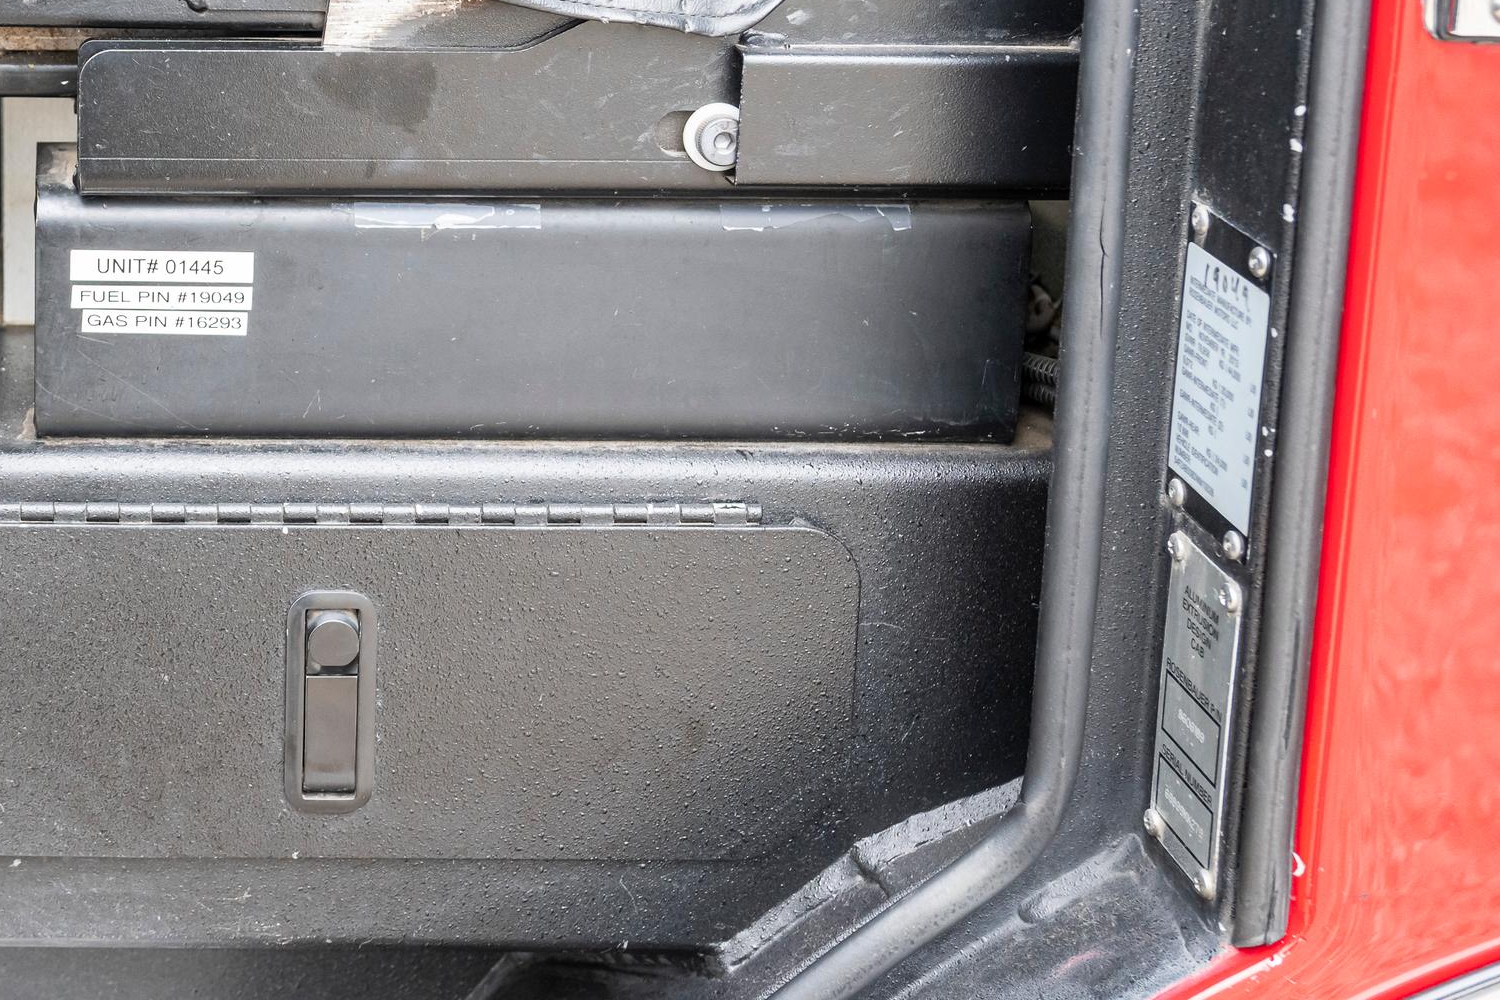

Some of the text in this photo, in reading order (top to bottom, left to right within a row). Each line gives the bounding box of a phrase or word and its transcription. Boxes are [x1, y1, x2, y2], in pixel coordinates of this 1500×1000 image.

[97, 258, 224, 275] UNIT# 01445
[80, 290, 245, 304] FUEL PIN #19049
[87, 314, 242, 329] GAS PIN #16293
[1182, 597, 1219, 641] EXTRUSION
[1184, 585, 1219, 625] ALUMINUM
[1186, 617, 1211, 650] DESIGN
[1190, 638, 1204, 658] CAB
[1166, 656, 1210, 710] ROSENBAUER
[1162, 743, 1183, 776] SERIAL
[1183, 768, 1212, 808] NUMBER
